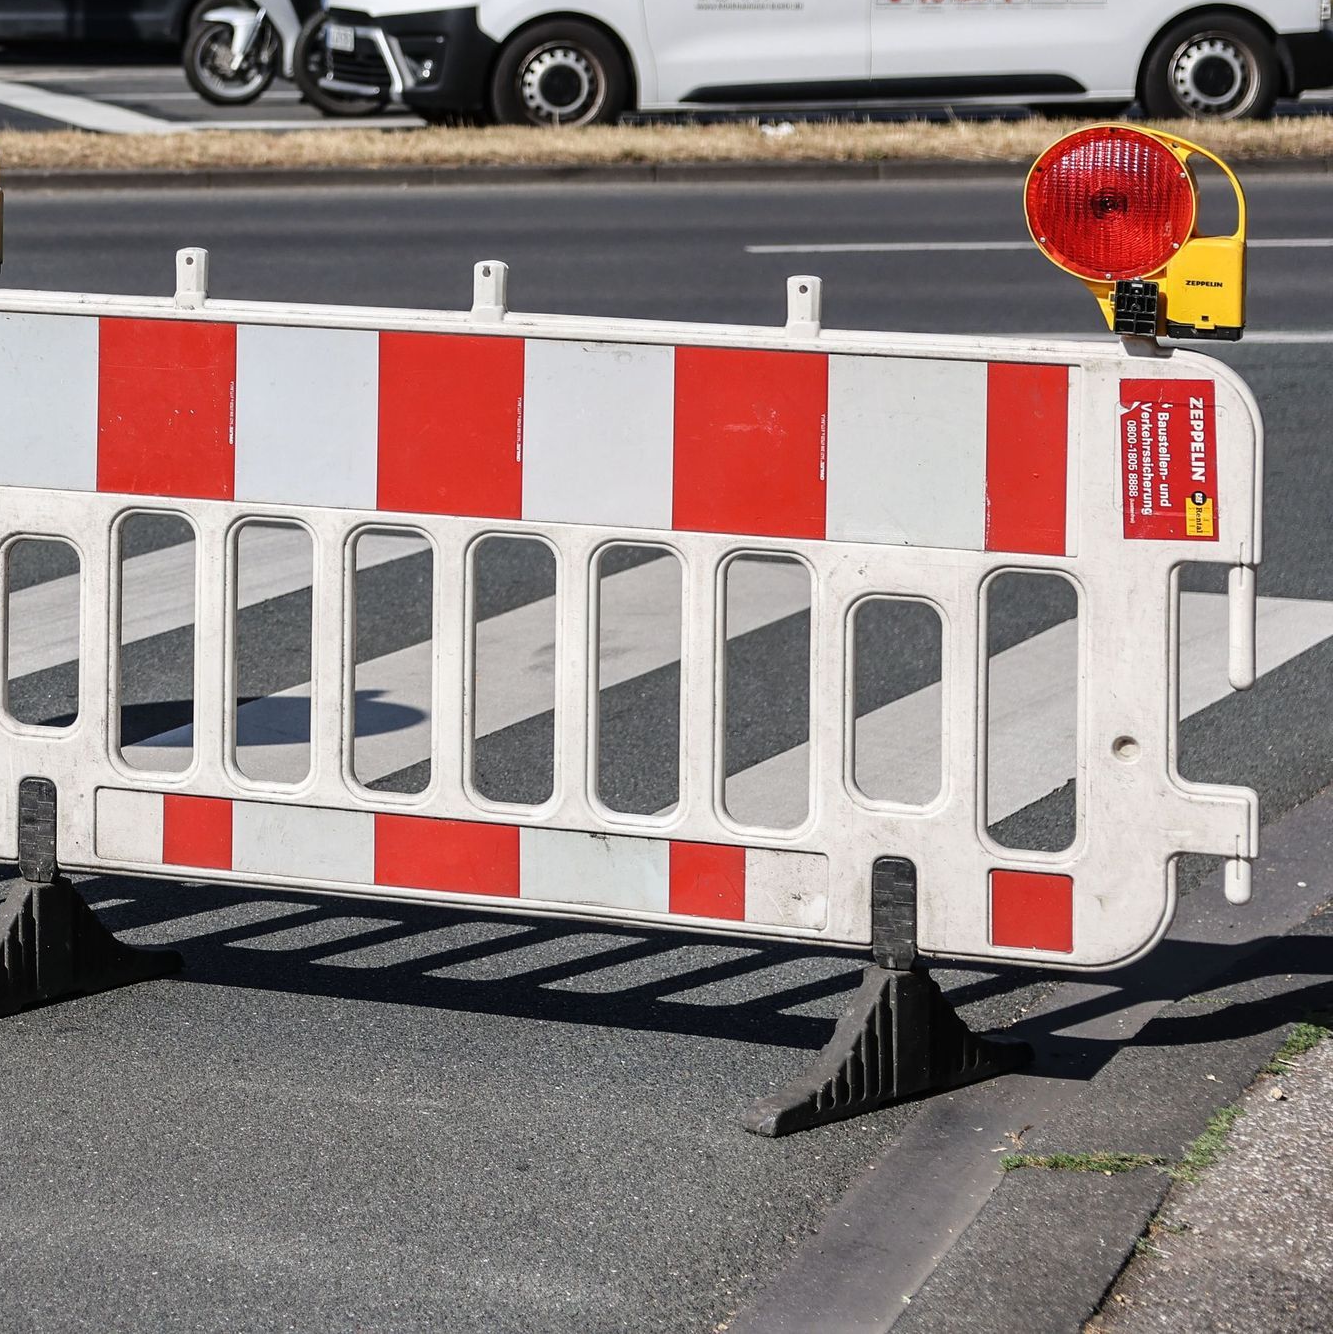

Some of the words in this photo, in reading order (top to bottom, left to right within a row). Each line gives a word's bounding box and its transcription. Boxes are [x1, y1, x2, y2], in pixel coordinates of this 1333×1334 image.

[1185, 279, 1223, 288] ZEPPELIN
[1126, 419, 1138, 471] 0800-1805
[1140, 402, 1155, 516] Verkehrssicherung
[1158, 412, 1171, 481] Baustellen-
[1189, 397, 1206, 483] ZEPPELIN
[1128, 473, 1138, 497] 8888
[1159, 483, 1172, 507] und
[1195, 507, 1204, 534] Rental
